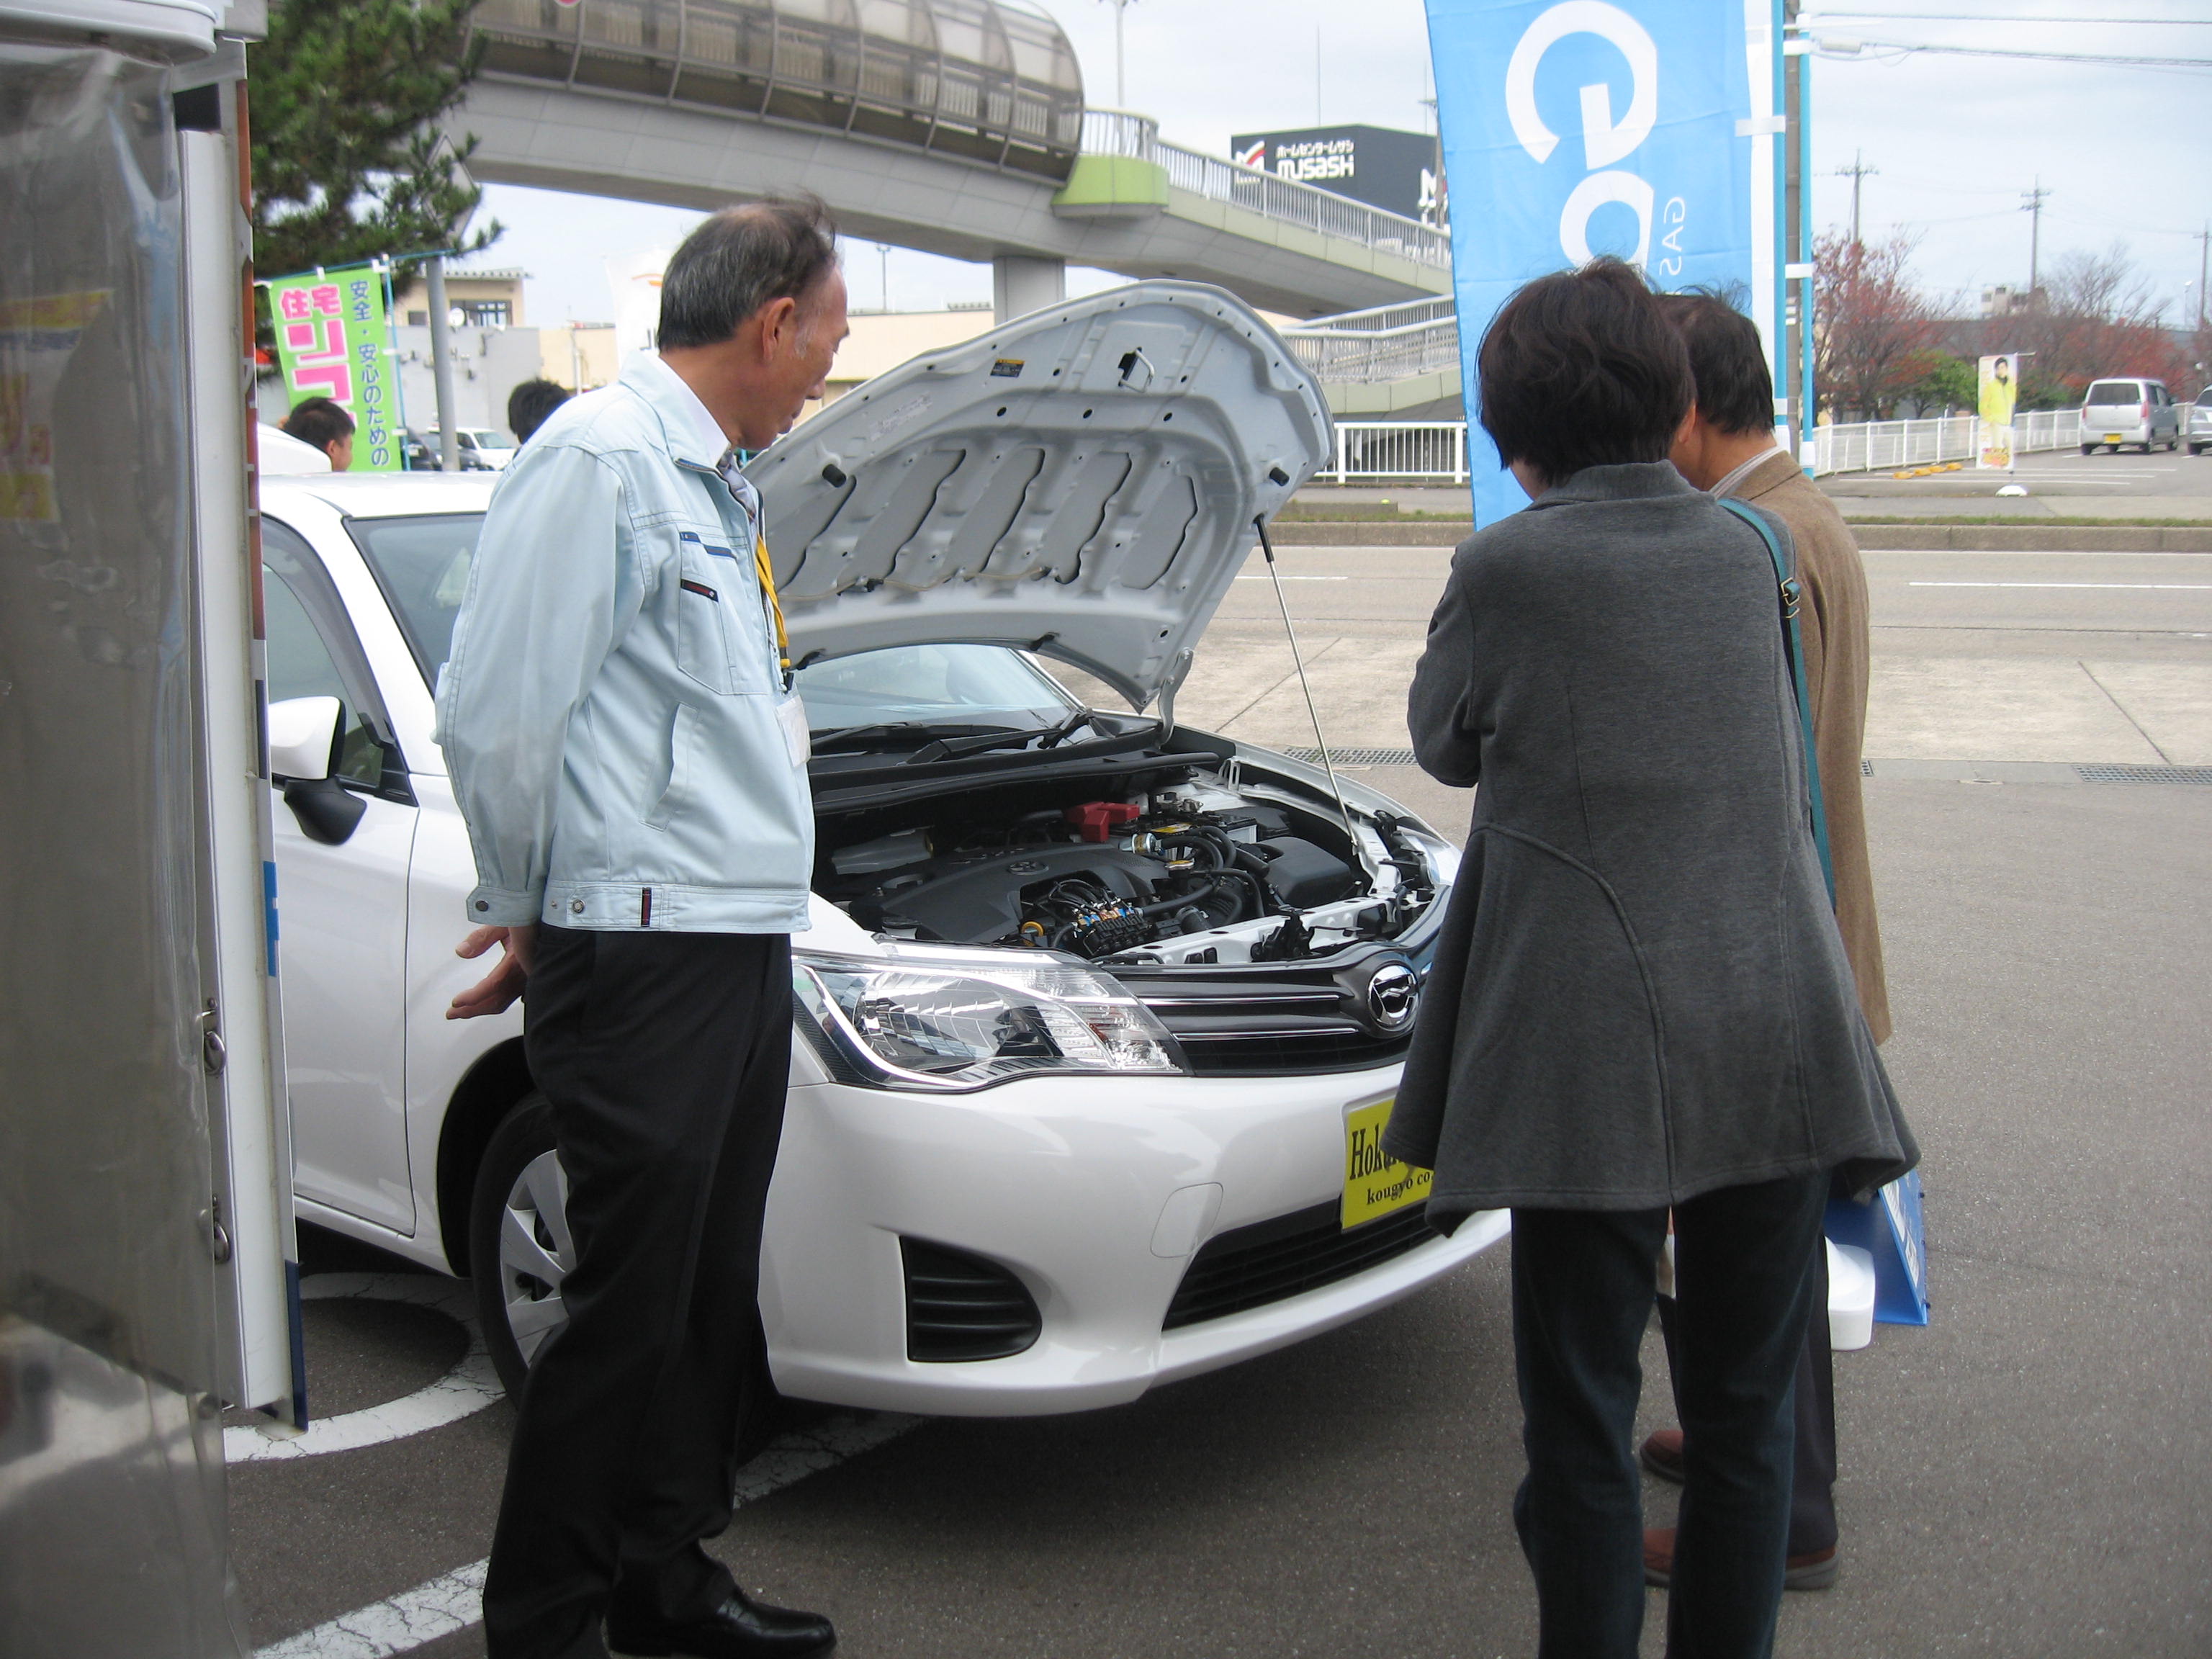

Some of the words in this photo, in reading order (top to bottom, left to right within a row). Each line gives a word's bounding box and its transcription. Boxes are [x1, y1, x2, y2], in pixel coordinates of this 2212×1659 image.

[350, 279, 390, 467] 安全・安心のための
[1367, 1179, 1413, 1205] kougyo
